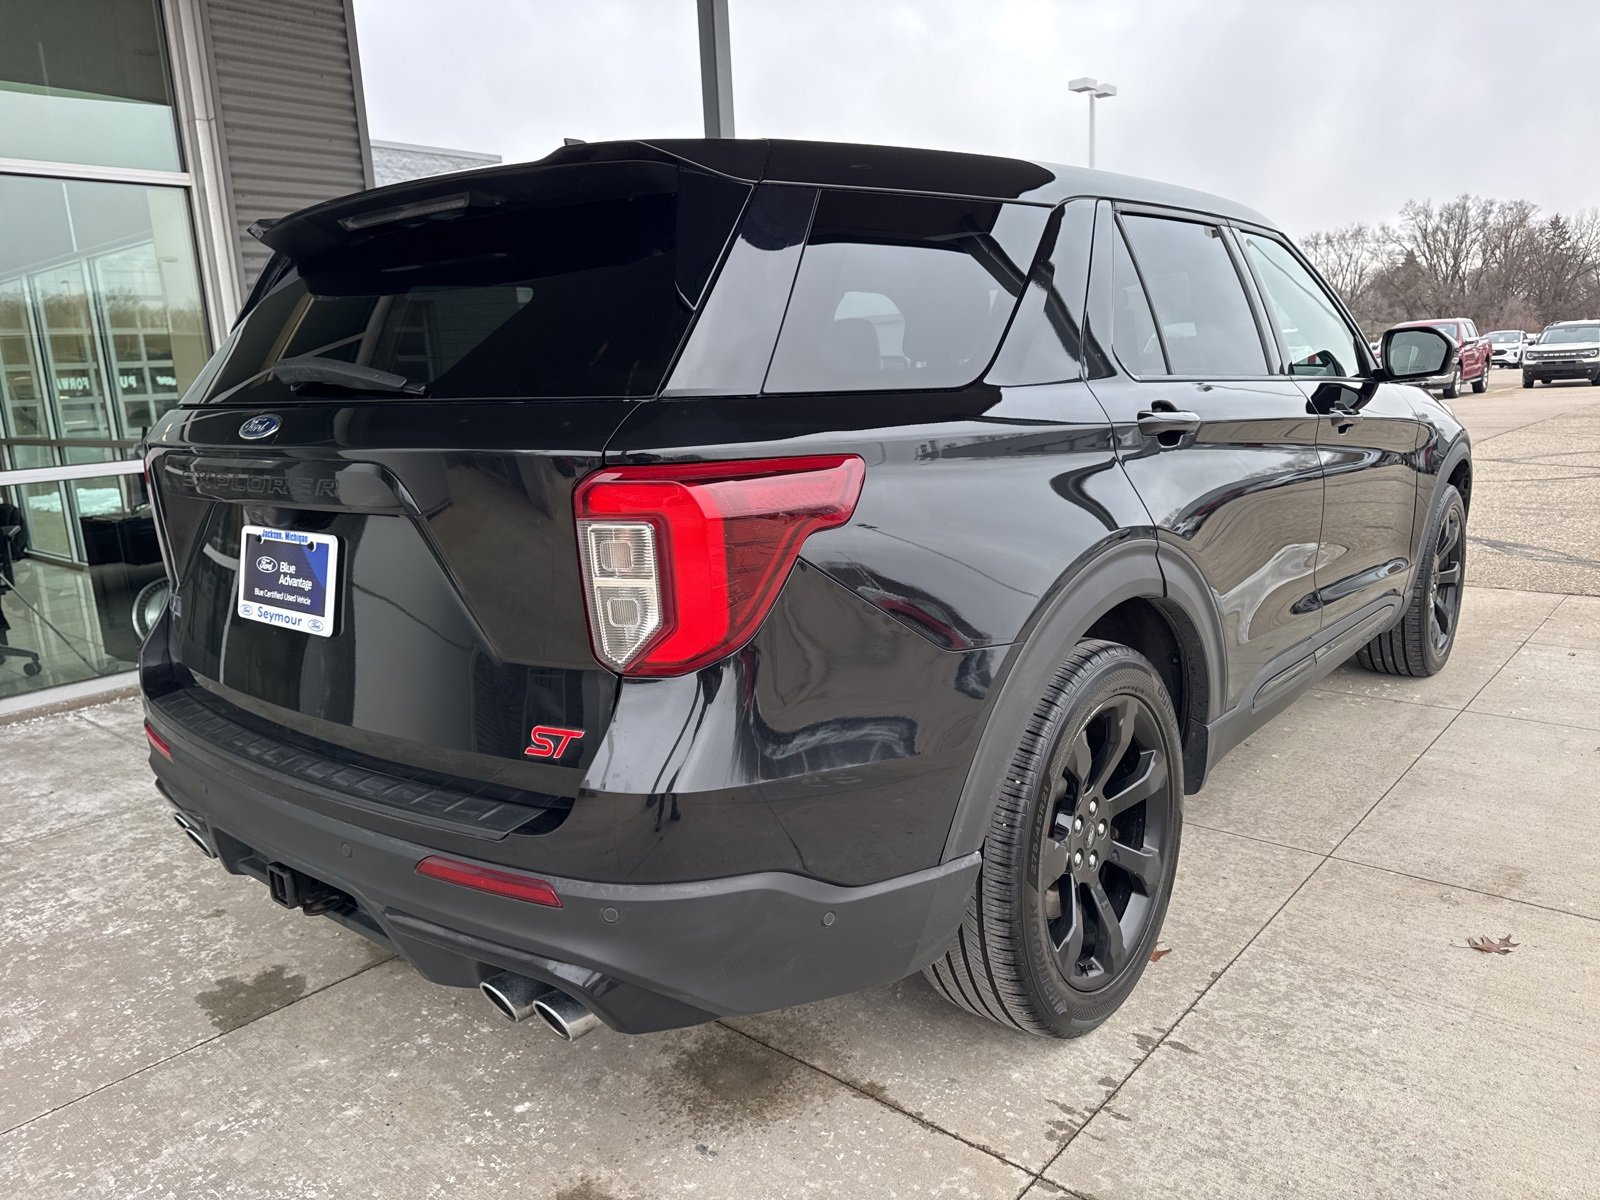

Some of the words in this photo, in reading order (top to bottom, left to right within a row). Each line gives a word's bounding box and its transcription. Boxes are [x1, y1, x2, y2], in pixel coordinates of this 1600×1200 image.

[183, 472, 336, 496] EXPLORER
[285, 532, 308, 543] Michigan
[280, 562, 296, 574] Blue
[279, 574, 313, 591] Advantage
[254, 587, 264, 597] Blue
[264, 589, 284, 601] Certified
[283, 593, 297, 603] Used
[297, 596, 311, 605] Vehicle
[257, 606, 302, 626] Seymour
[524, 725, 585, 759] ST
[1030, 784, 1050, 876] 275/45R21
